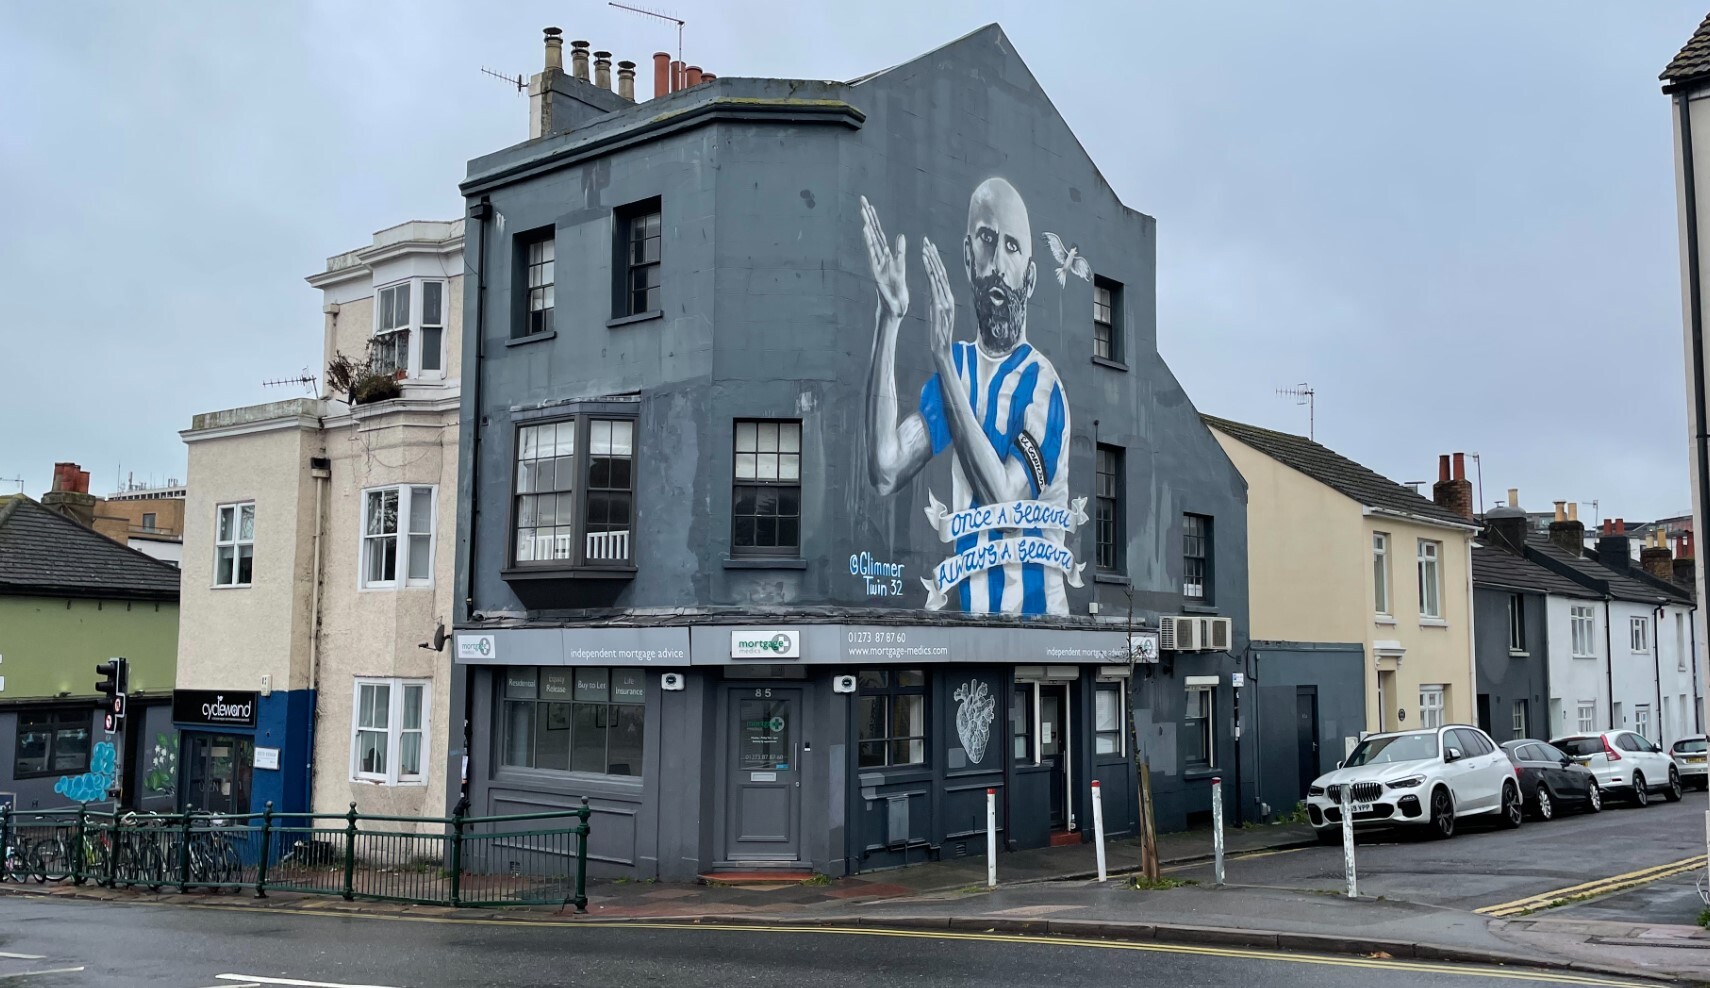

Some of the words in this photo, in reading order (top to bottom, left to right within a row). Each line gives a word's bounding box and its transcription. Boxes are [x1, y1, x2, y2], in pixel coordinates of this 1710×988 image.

[997, 506, 1007, 525] A
[1001, 542, 1011, 560] A
[849, 551, 905, 577] @Glimmer
[863, 575, 888, 596] Twin
[890, 579, 904, 596] 32
[848, 631, 872, 643] 01273
[875, 632, 885, 643] 87
[886, 632, 896, 643] 87
[897, 632, 906, 643] 60
[738, 639, 784, 651] mortgage
[848, 644, 948, 658] www.mortgage-medics.com
[570, 648, 617, 660] independent
[618, 649, 656, 661] mortgage
[657, 648, 684, 658] advice
[1046, 647, 1081, 658] independent
[508, 678, 536, 688] Residential
[577, 680, 588, 690] Buy
[596, 681, 606, 689] Let
[615, 686, 643, 696] Insurance
[755, 688, 772, 698] 85
[202, 697, 252, 720] cyclewand
